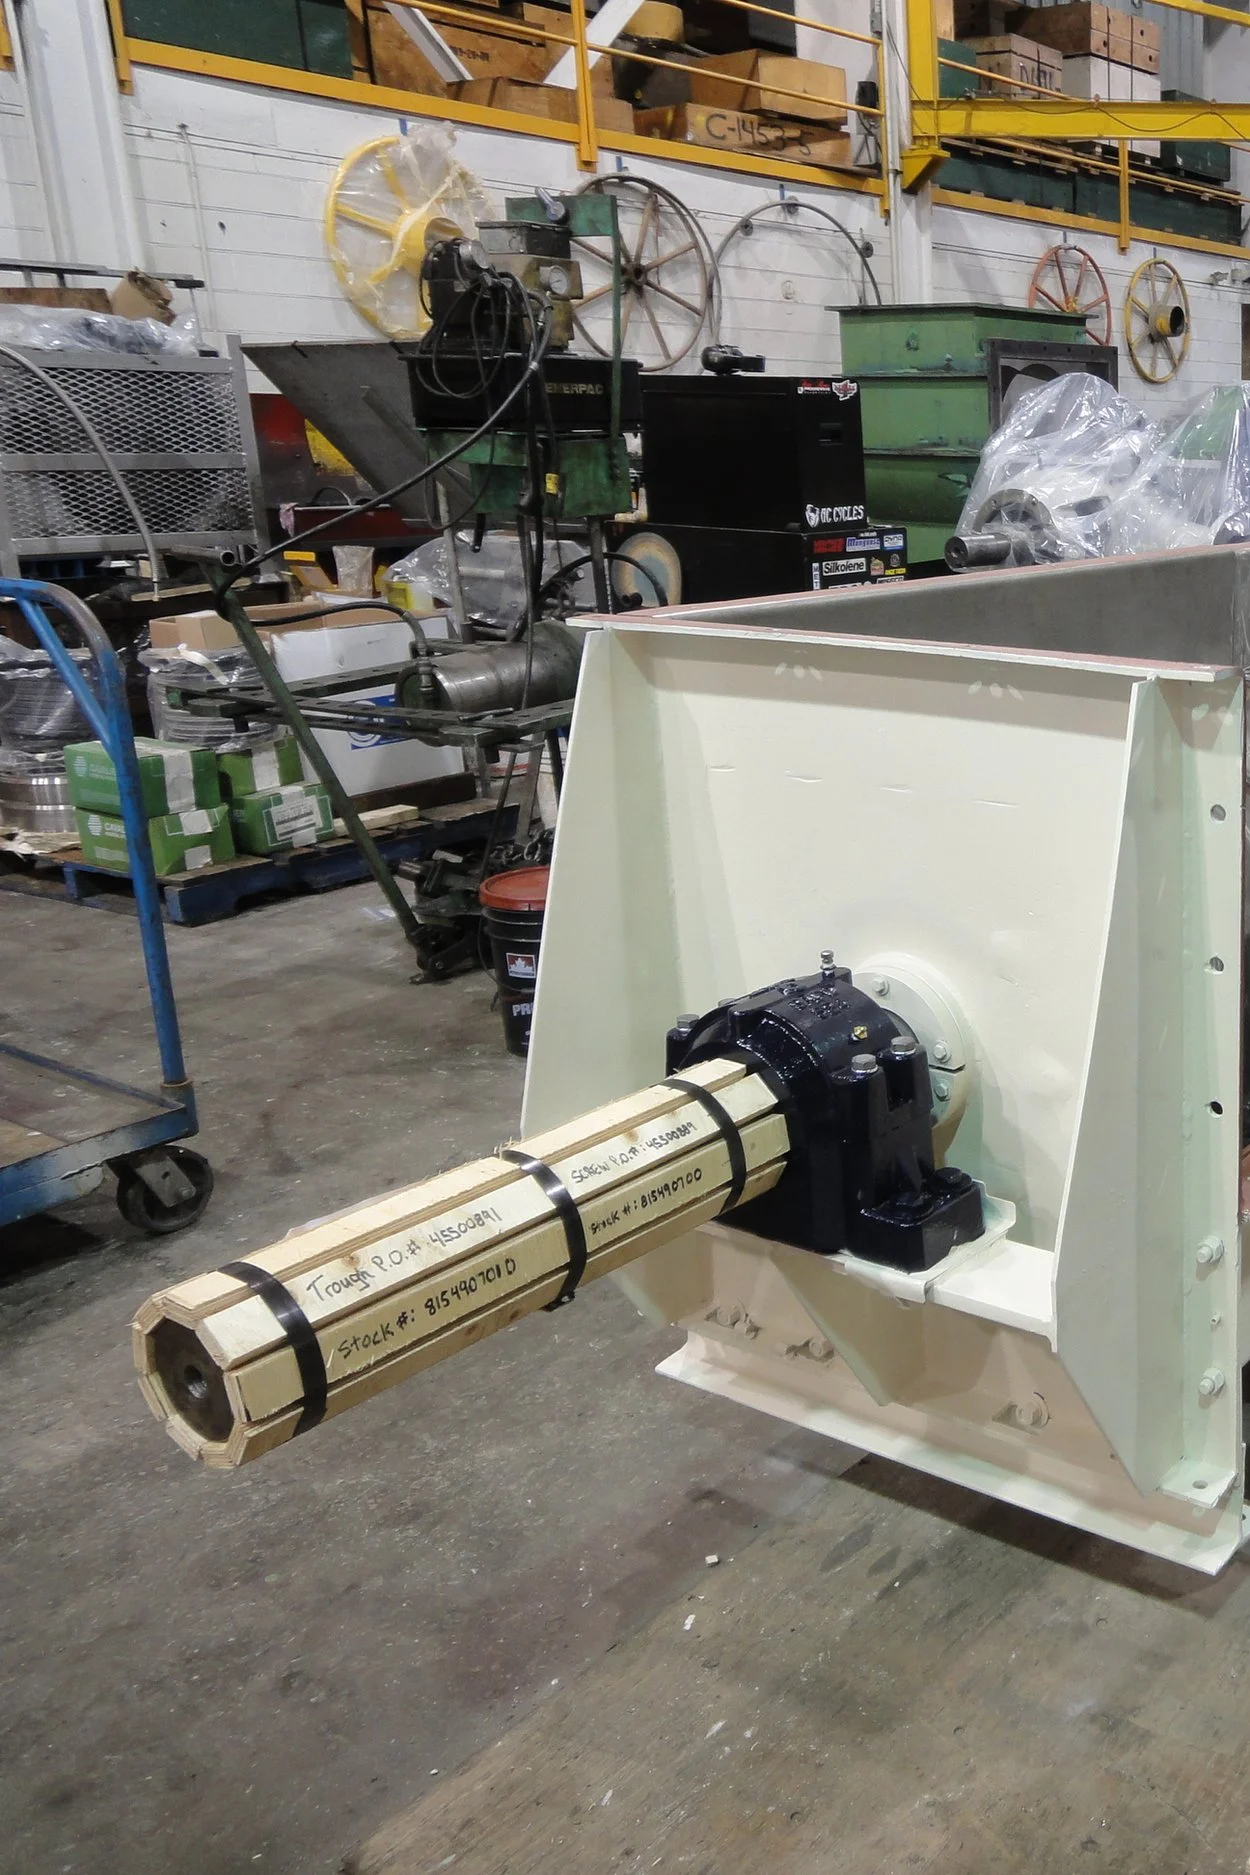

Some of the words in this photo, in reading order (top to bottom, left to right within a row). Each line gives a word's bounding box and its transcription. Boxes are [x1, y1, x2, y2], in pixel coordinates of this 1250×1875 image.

[833, 505, 864, 522] CYCLES
[824, 560, 865, 574] Silkolene
[306, 1267, 376, 1302] Trough
[429, 1207, 502, 1248] 45500891
